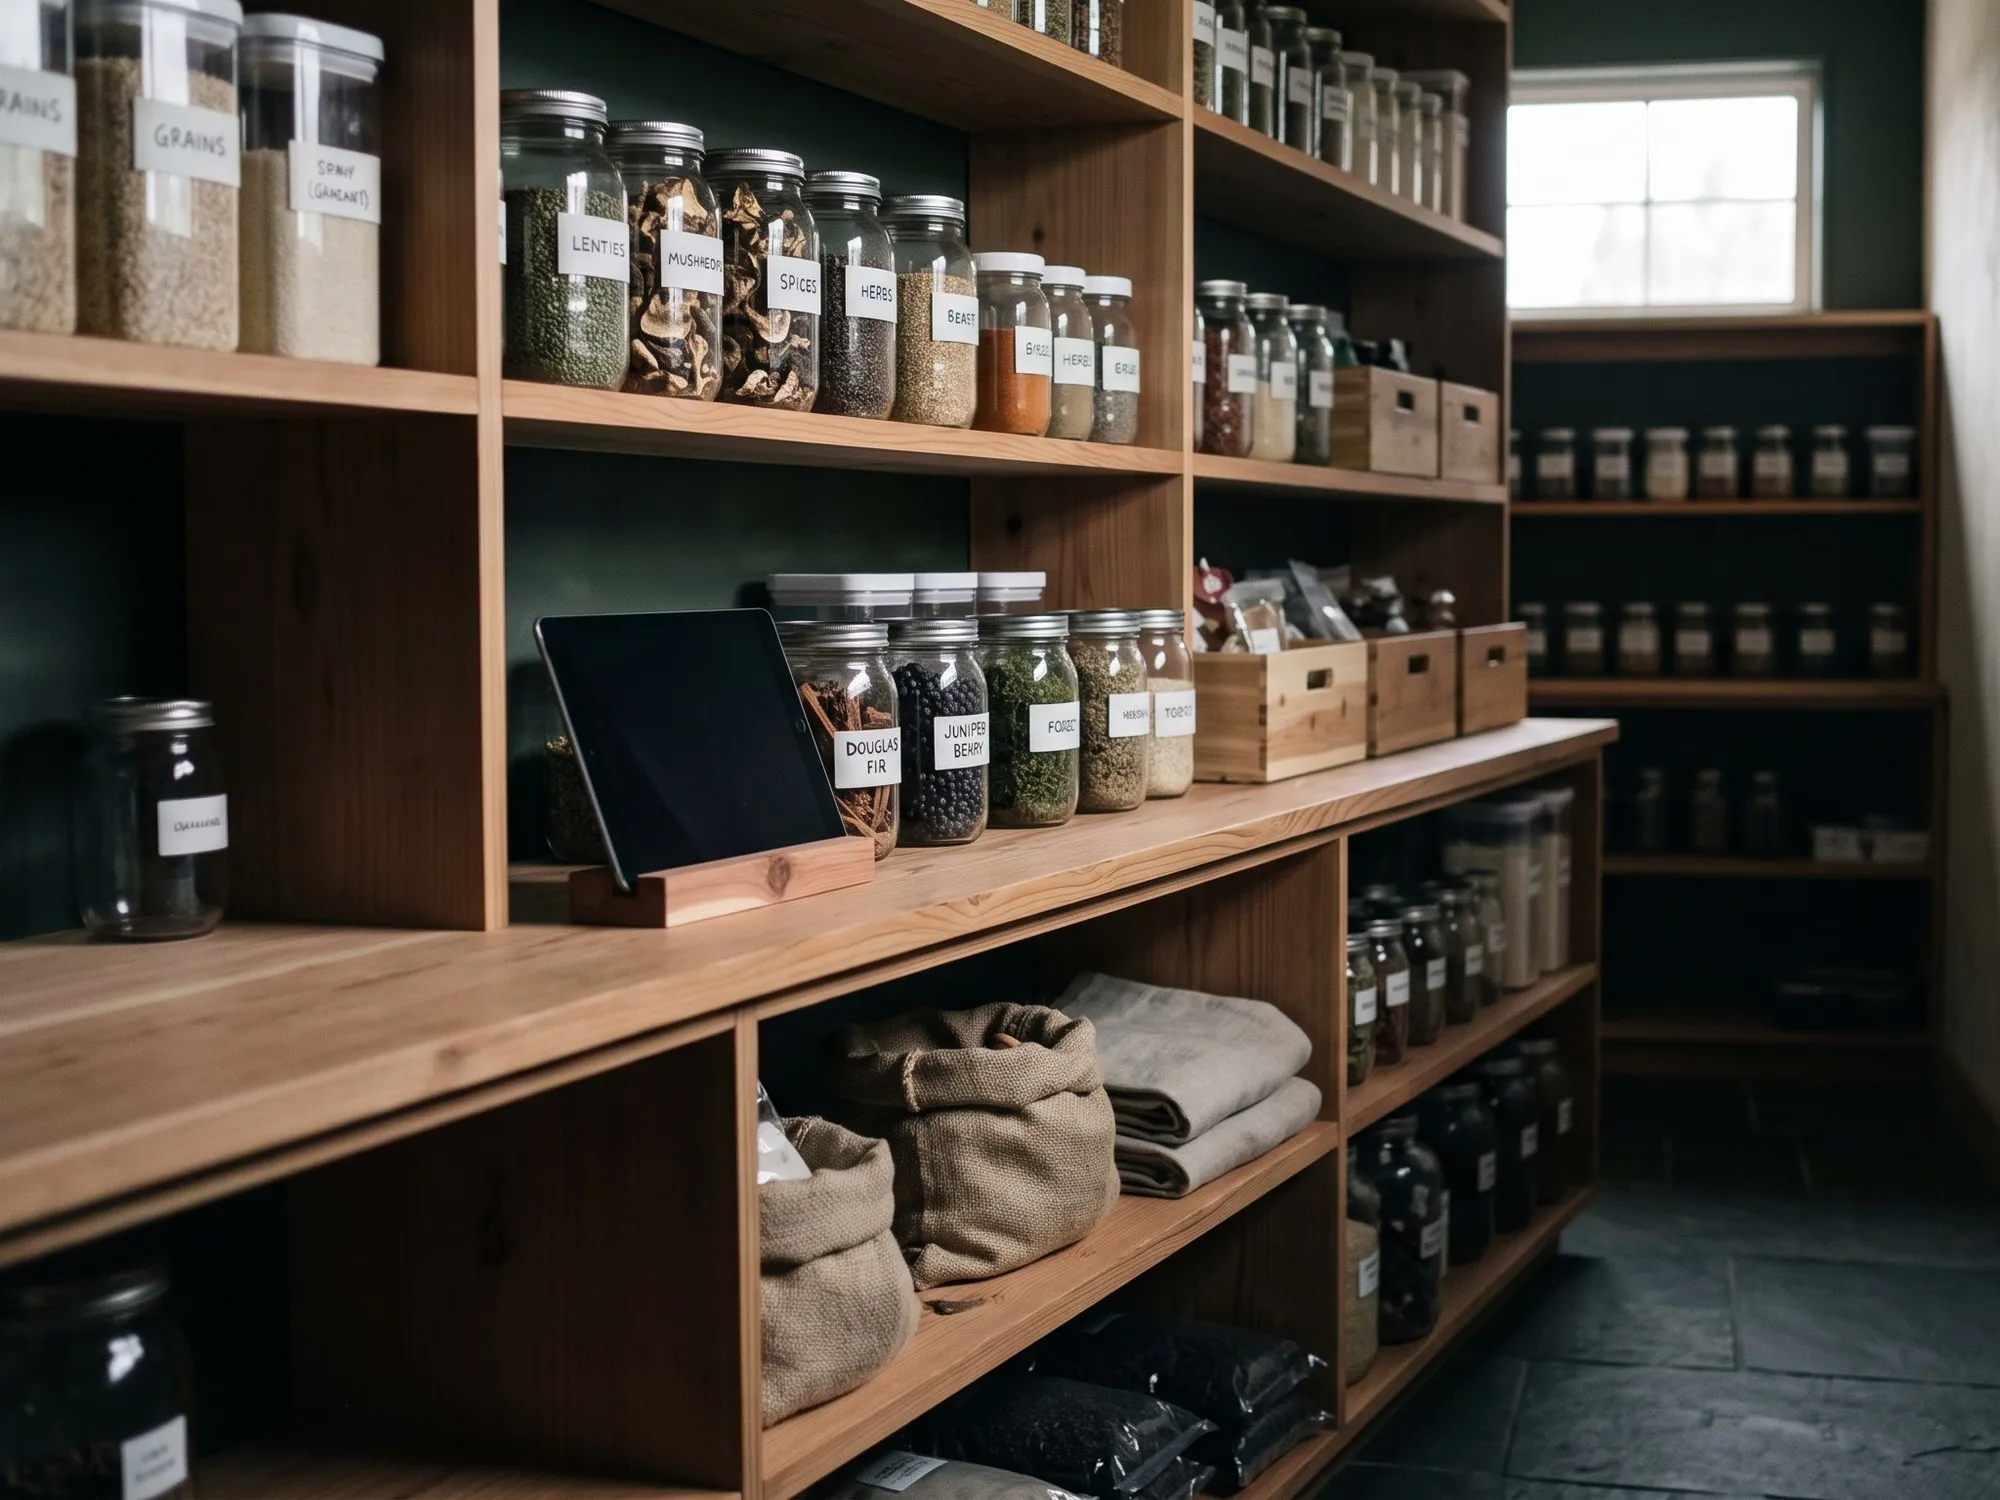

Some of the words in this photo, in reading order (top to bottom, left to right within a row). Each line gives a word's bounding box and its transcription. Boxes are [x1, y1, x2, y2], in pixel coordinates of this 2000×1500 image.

[153, 122, 227, 157] GRAINS
[572, 235, 625, 258] LENTIES
[780, 273, 817, 294] SPICES
[861, 285, 893, 302] HERBS
[846, 736, 899, 757] DOUGLAS
[867, 758, 887, 774] FIR
